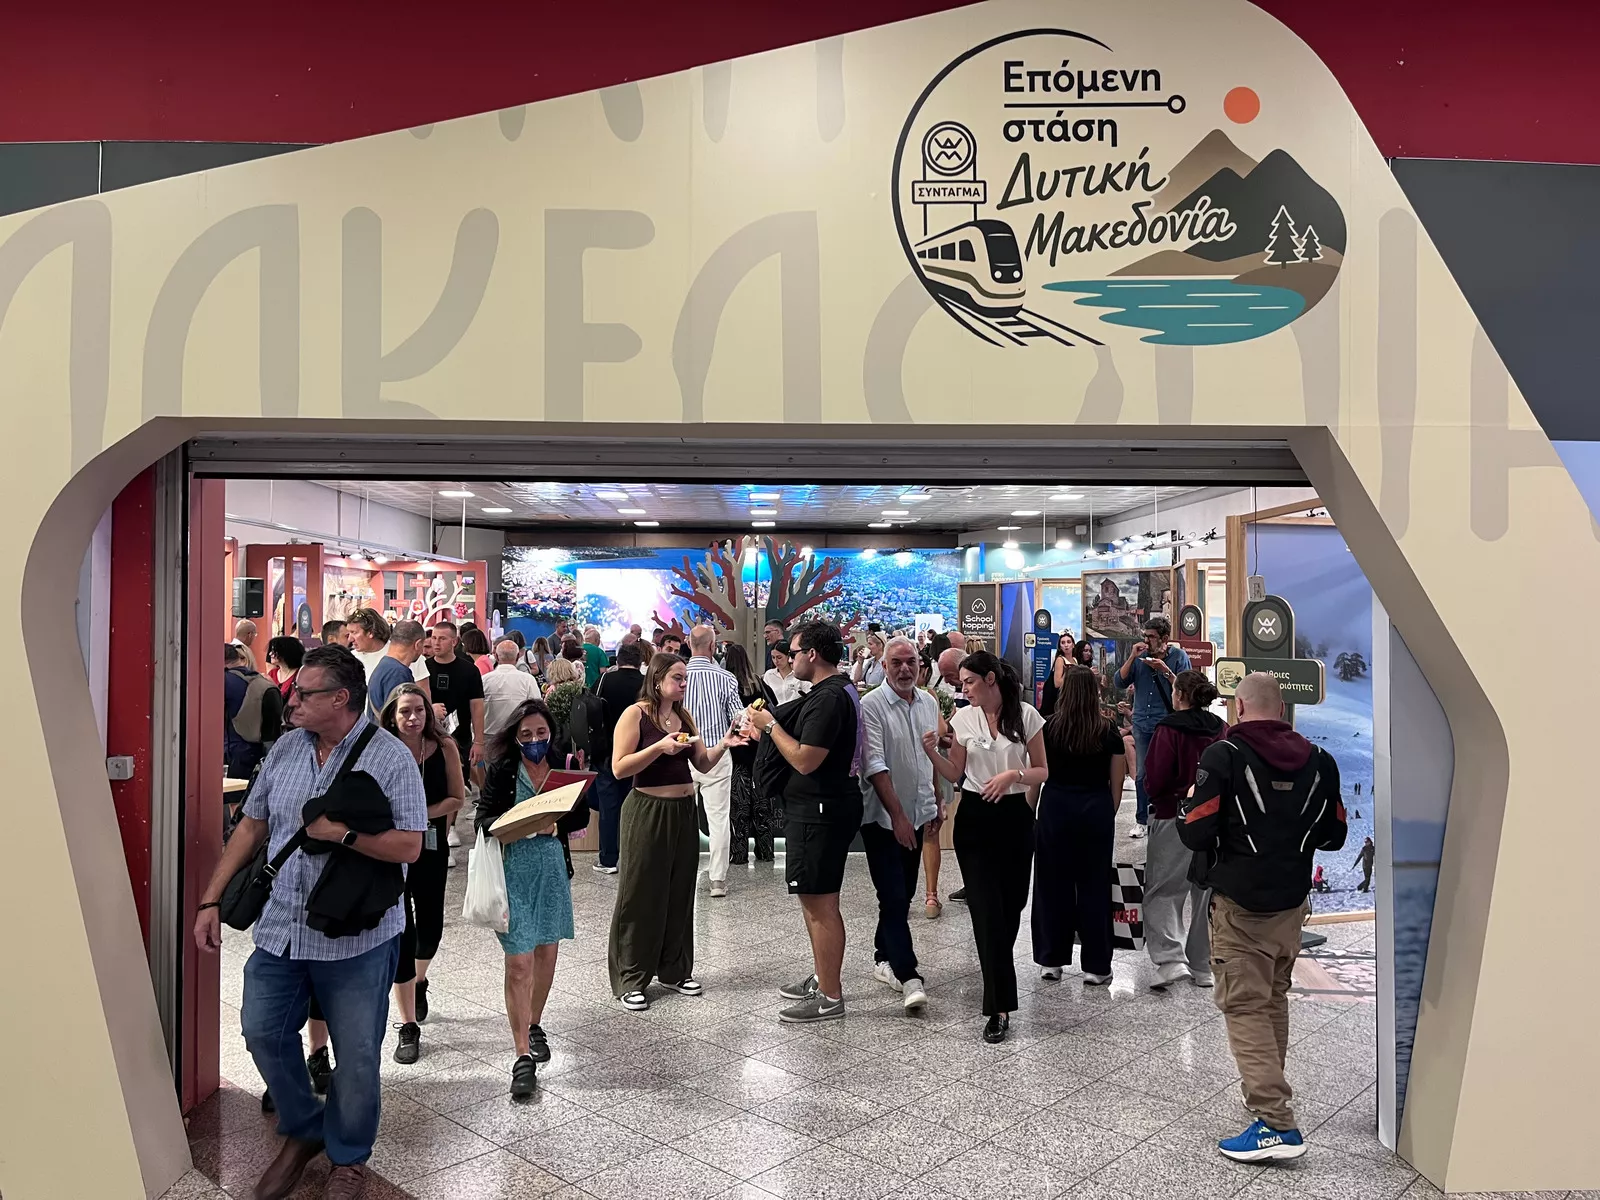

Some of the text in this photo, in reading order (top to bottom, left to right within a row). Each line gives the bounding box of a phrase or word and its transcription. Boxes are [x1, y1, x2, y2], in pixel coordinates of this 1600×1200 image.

[1003, 60, 1161, 98] Επόμενη
[1002, 111, 1118, 147] στάση
[997, 147, 1167, 210] Δυτική
[918, 187, 980, 197] ΣΥΝΤΑΓΜΑ
[1025, 198, 1235, 267] Μακεδονία
[962, 621, 996, 630] hopping!
[965, 614, 993, 622] School
[1257, 1135, 1283, 1148] HOKA
